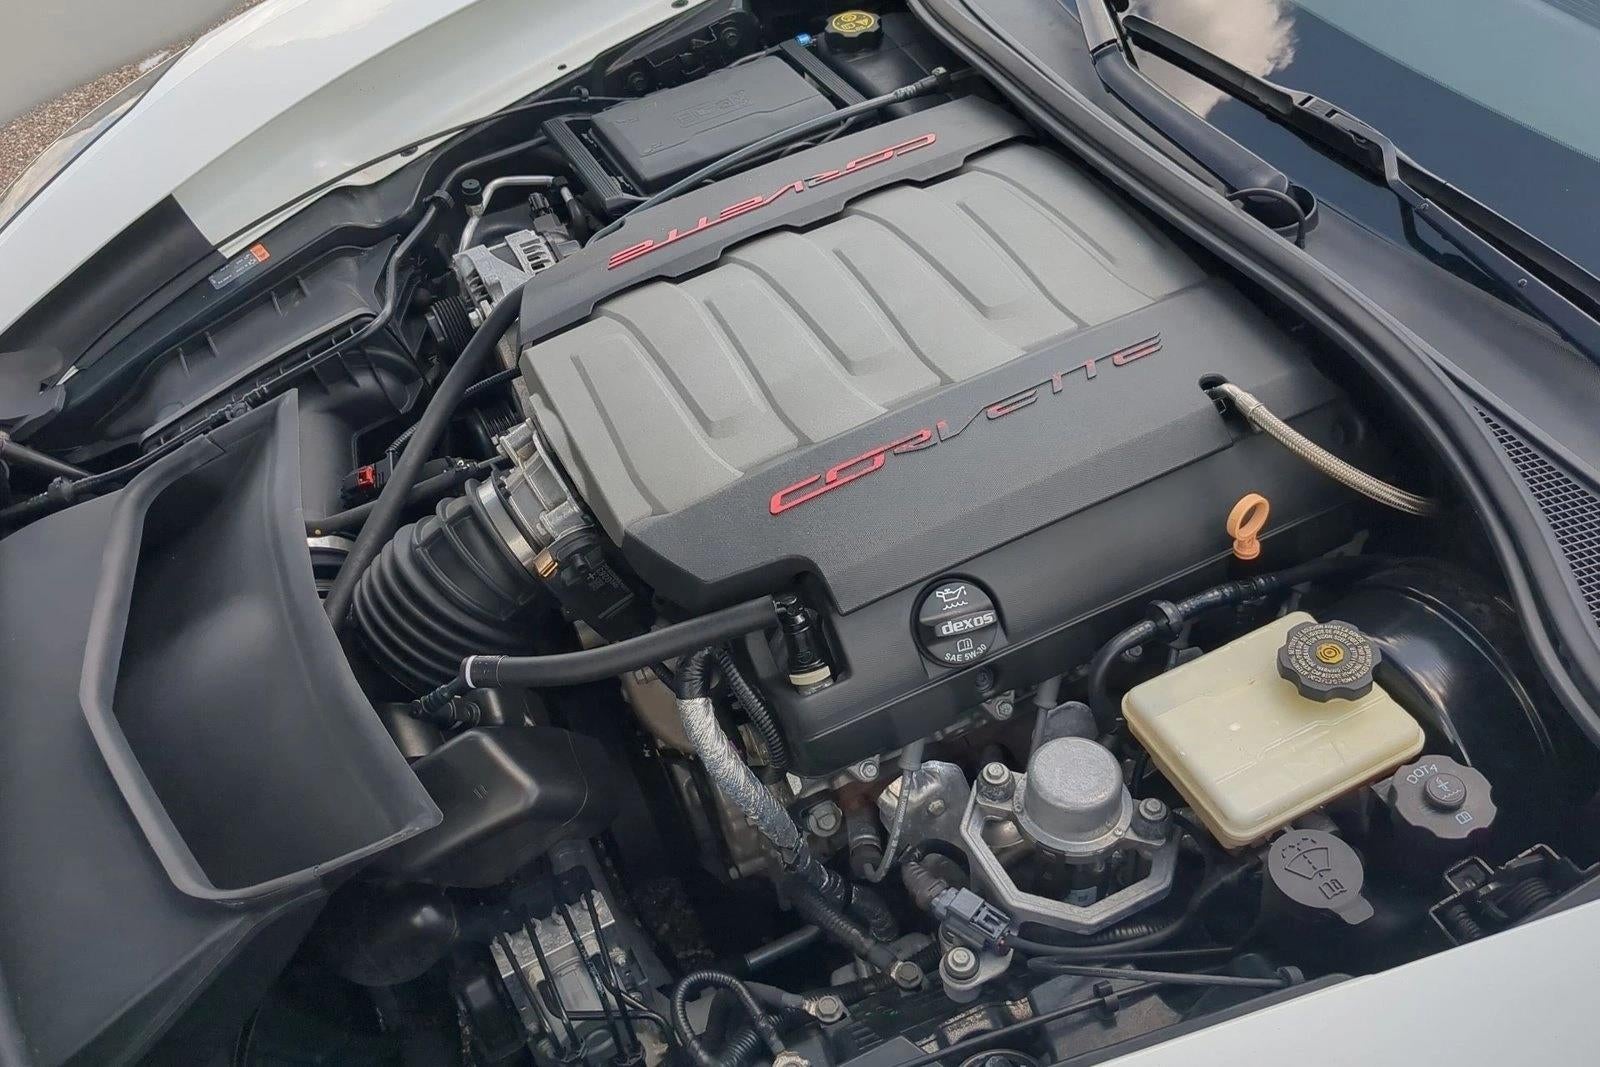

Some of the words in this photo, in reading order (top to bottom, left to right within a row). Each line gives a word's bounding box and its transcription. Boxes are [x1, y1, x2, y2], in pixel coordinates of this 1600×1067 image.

[607, 132, 937, 270] CORVETTE
[768, 331, 1163, 516] CORVETTE
[941, 612, 995, 635] dexos
[944, 652, 963, 662] SAE
[964, 643, 987, 660] 5W-30
